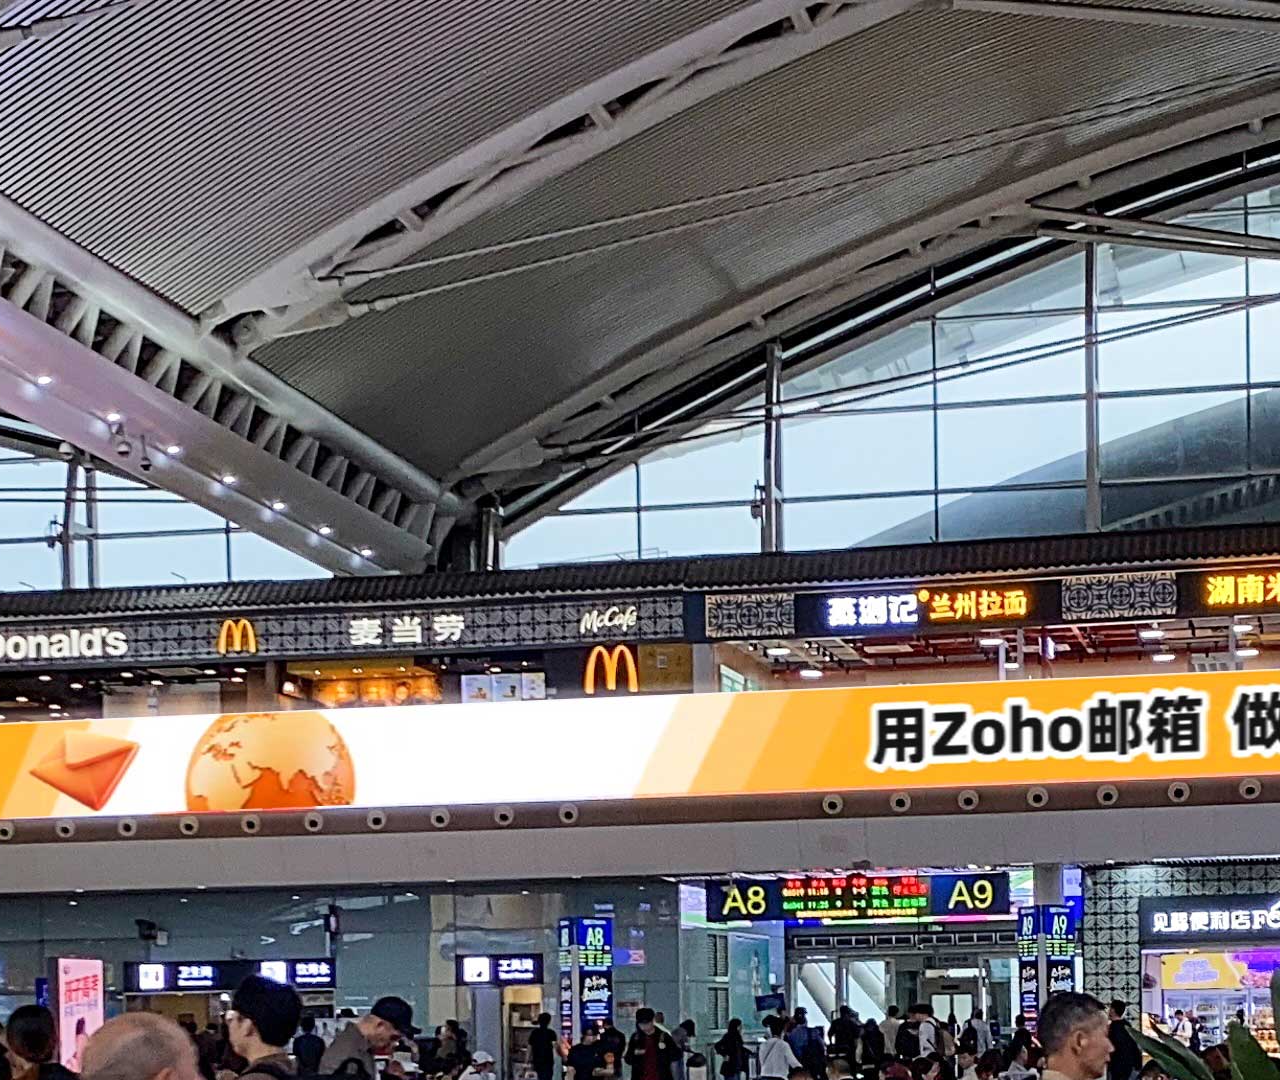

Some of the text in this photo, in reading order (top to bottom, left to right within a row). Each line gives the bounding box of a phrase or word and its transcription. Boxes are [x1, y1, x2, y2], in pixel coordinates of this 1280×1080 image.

[928, 590, 1028, 621] 兰州拉面
[349, 612, 466, 646] 麦当劳
[873, 695, 1202, 765] 用Zoho邮箱
[722, 886, 767, 915] A8
[948, 879, 993, 910] A9
[586, 926, 605, 946] A8
[1022, 915, 1034, 935] A9
[1053, 914, 1068, 935] A9
